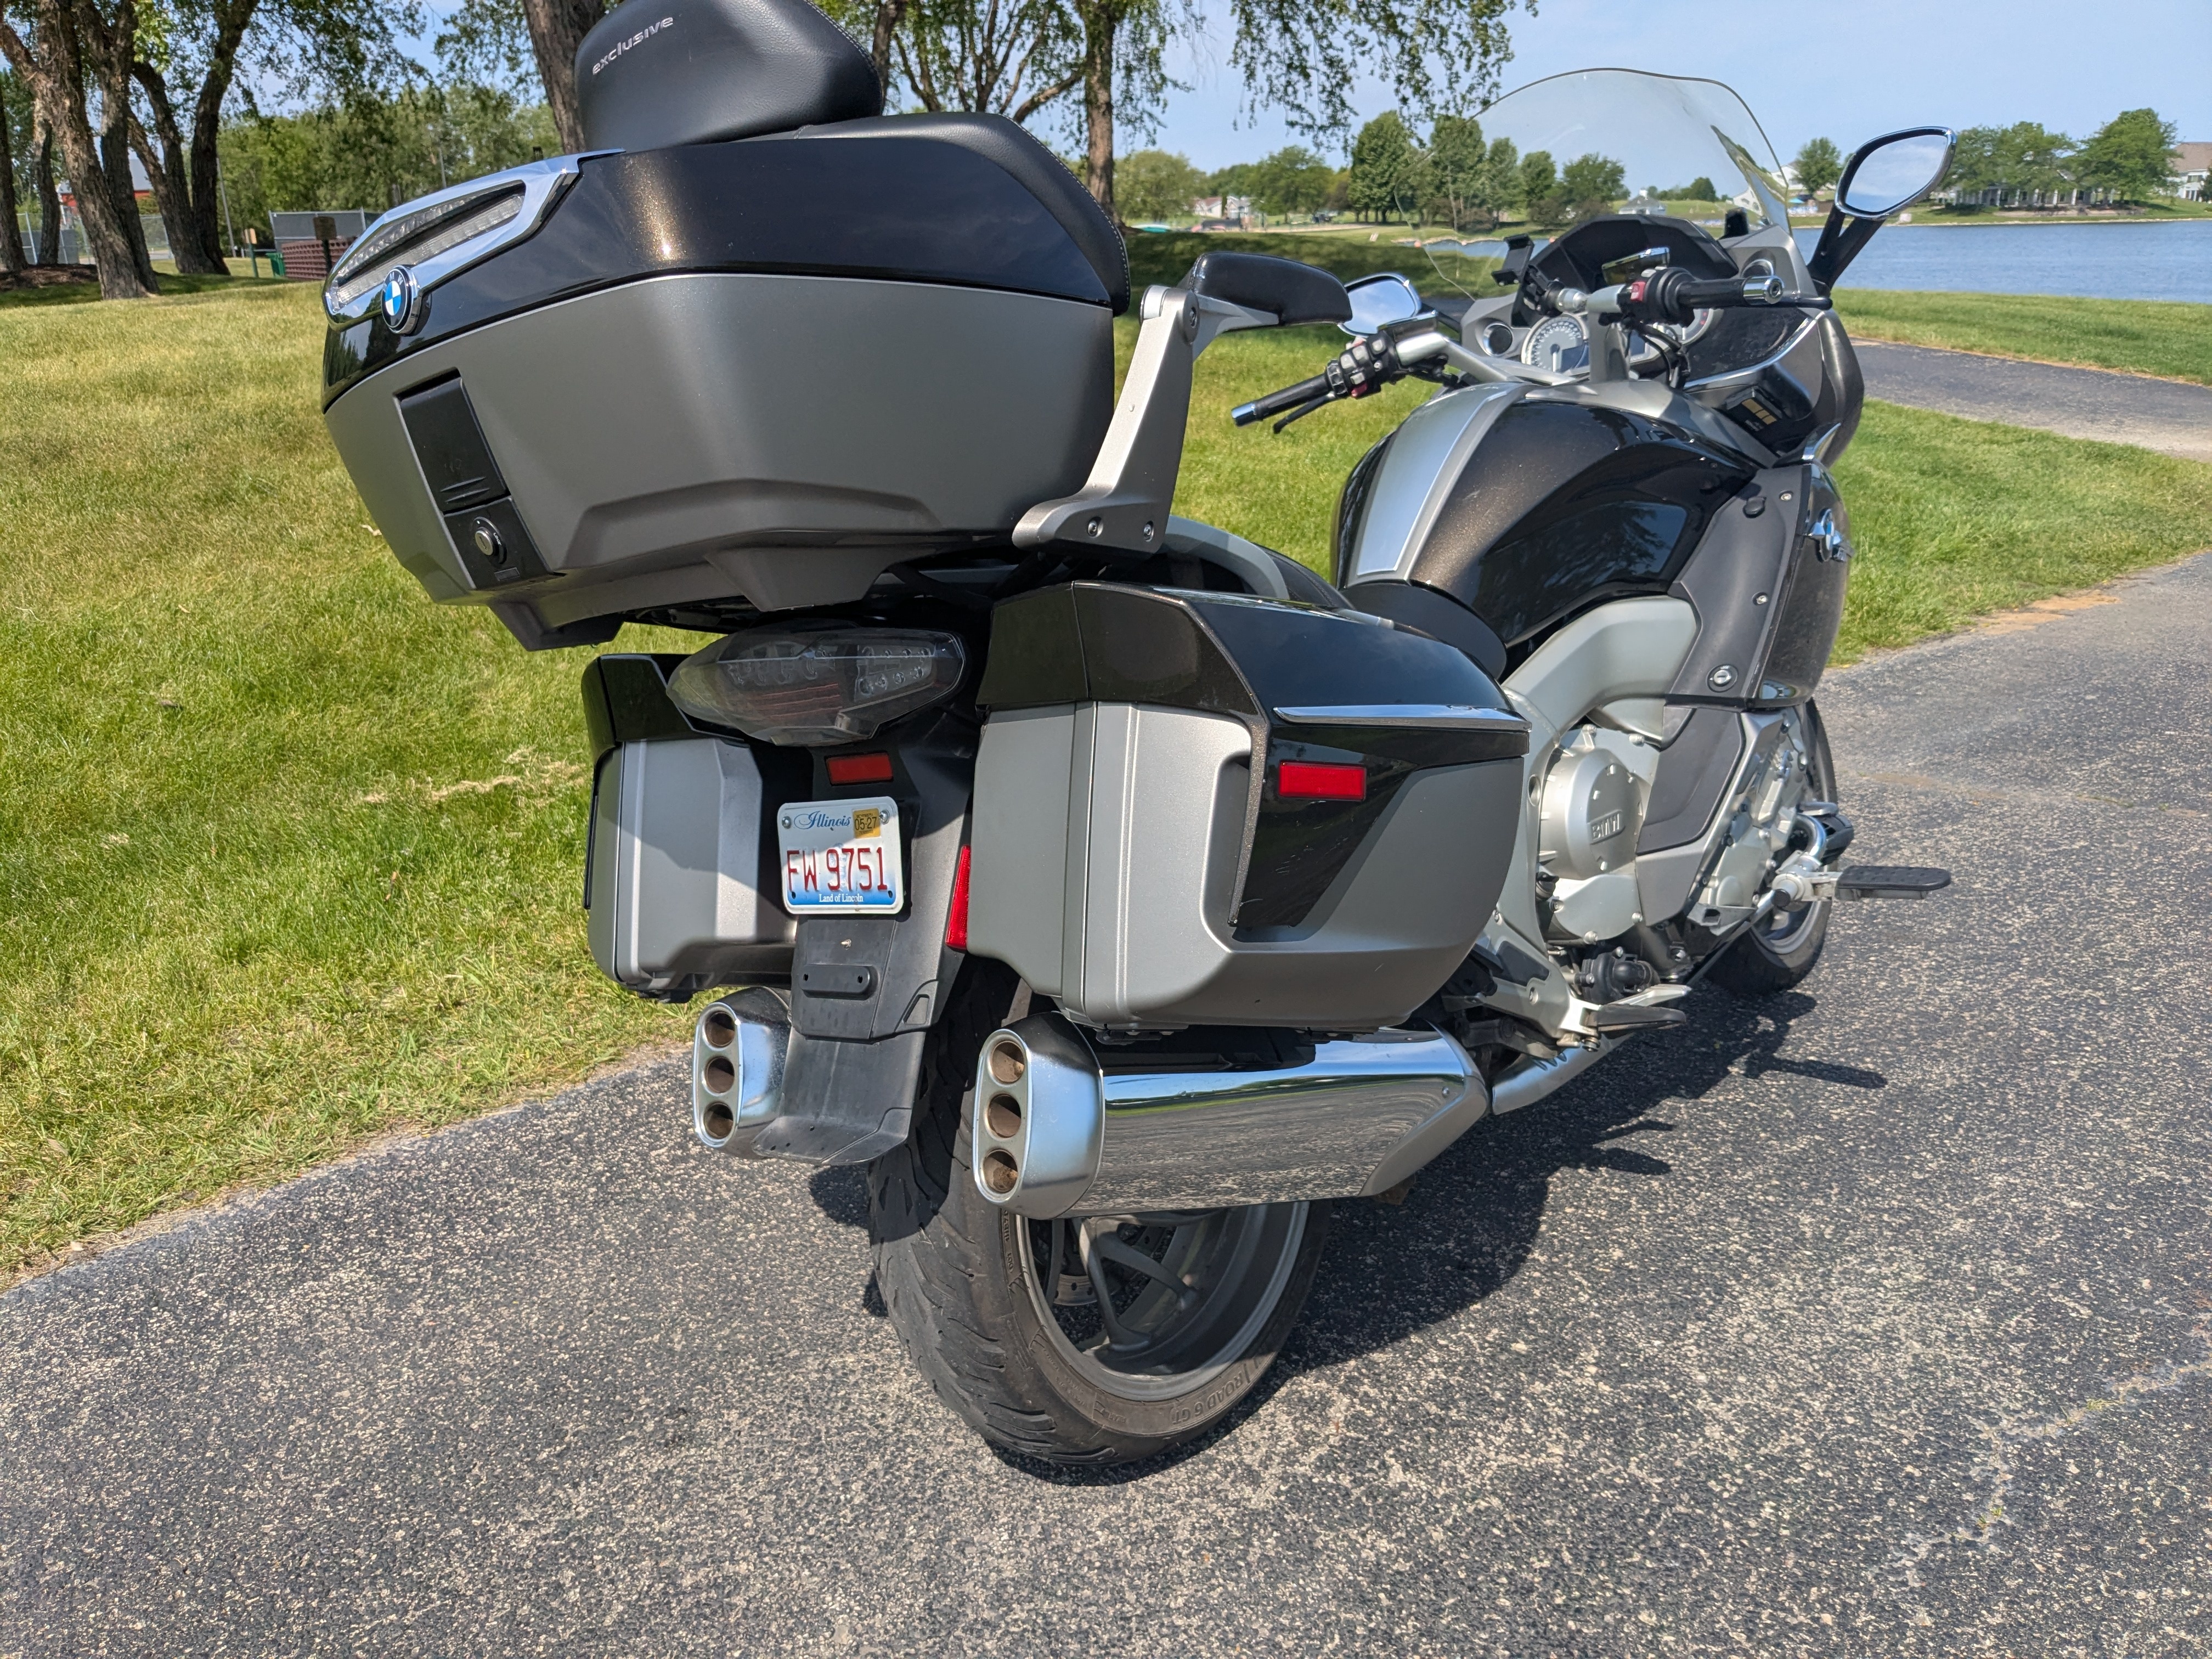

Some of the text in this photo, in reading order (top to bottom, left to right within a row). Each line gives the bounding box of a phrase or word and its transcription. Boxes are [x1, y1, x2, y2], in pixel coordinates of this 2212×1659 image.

[592, 17, 674, 75] exclusive
[794, 810, 851, 830] Illinois
[855, 816, 877, 831] 05-27
[1592, 813, 1620, 838] BMW
[787, 847, 888, 891] FW 9751
[819, 893, 863, 902] Land of Lincoln
[1207, 1371, 1243, 1409] ROAD
